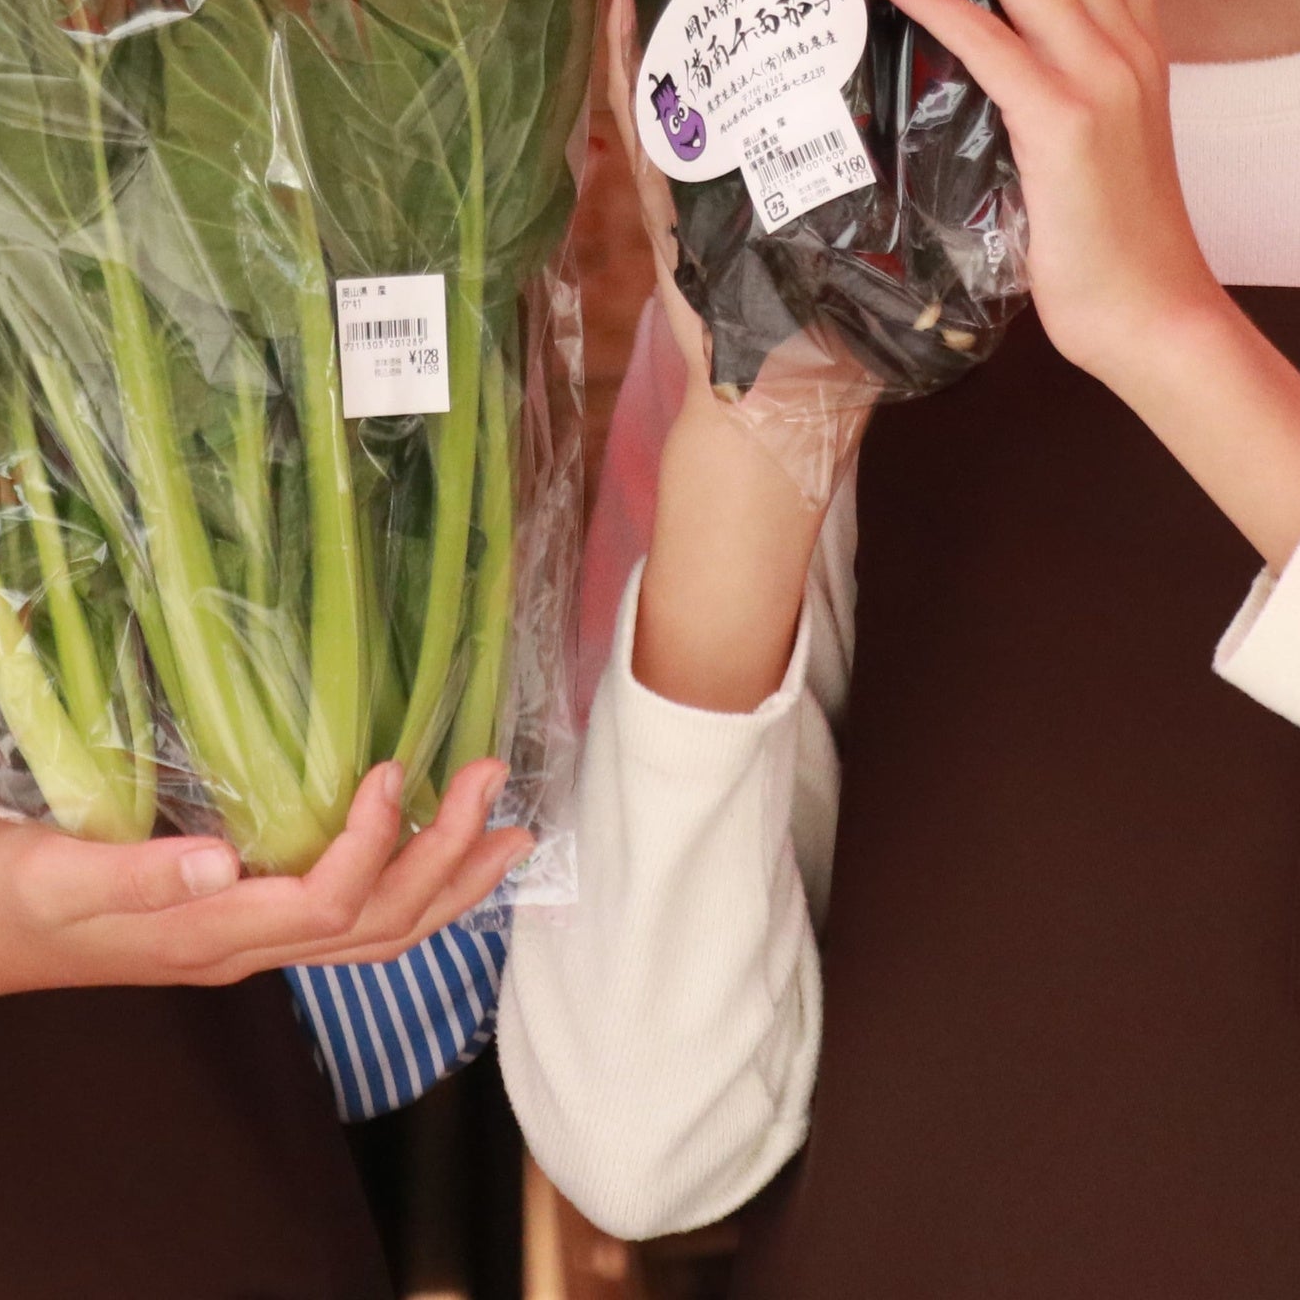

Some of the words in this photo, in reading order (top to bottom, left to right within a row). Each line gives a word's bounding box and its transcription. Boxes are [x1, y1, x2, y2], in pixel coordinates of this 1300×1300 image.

[833, 155, 866, 177] ¥160
[848, 170, 870, 183] ¥173
[409, 349, 439, 365] ¥128
[416, 364, 439, 375] ¥139
